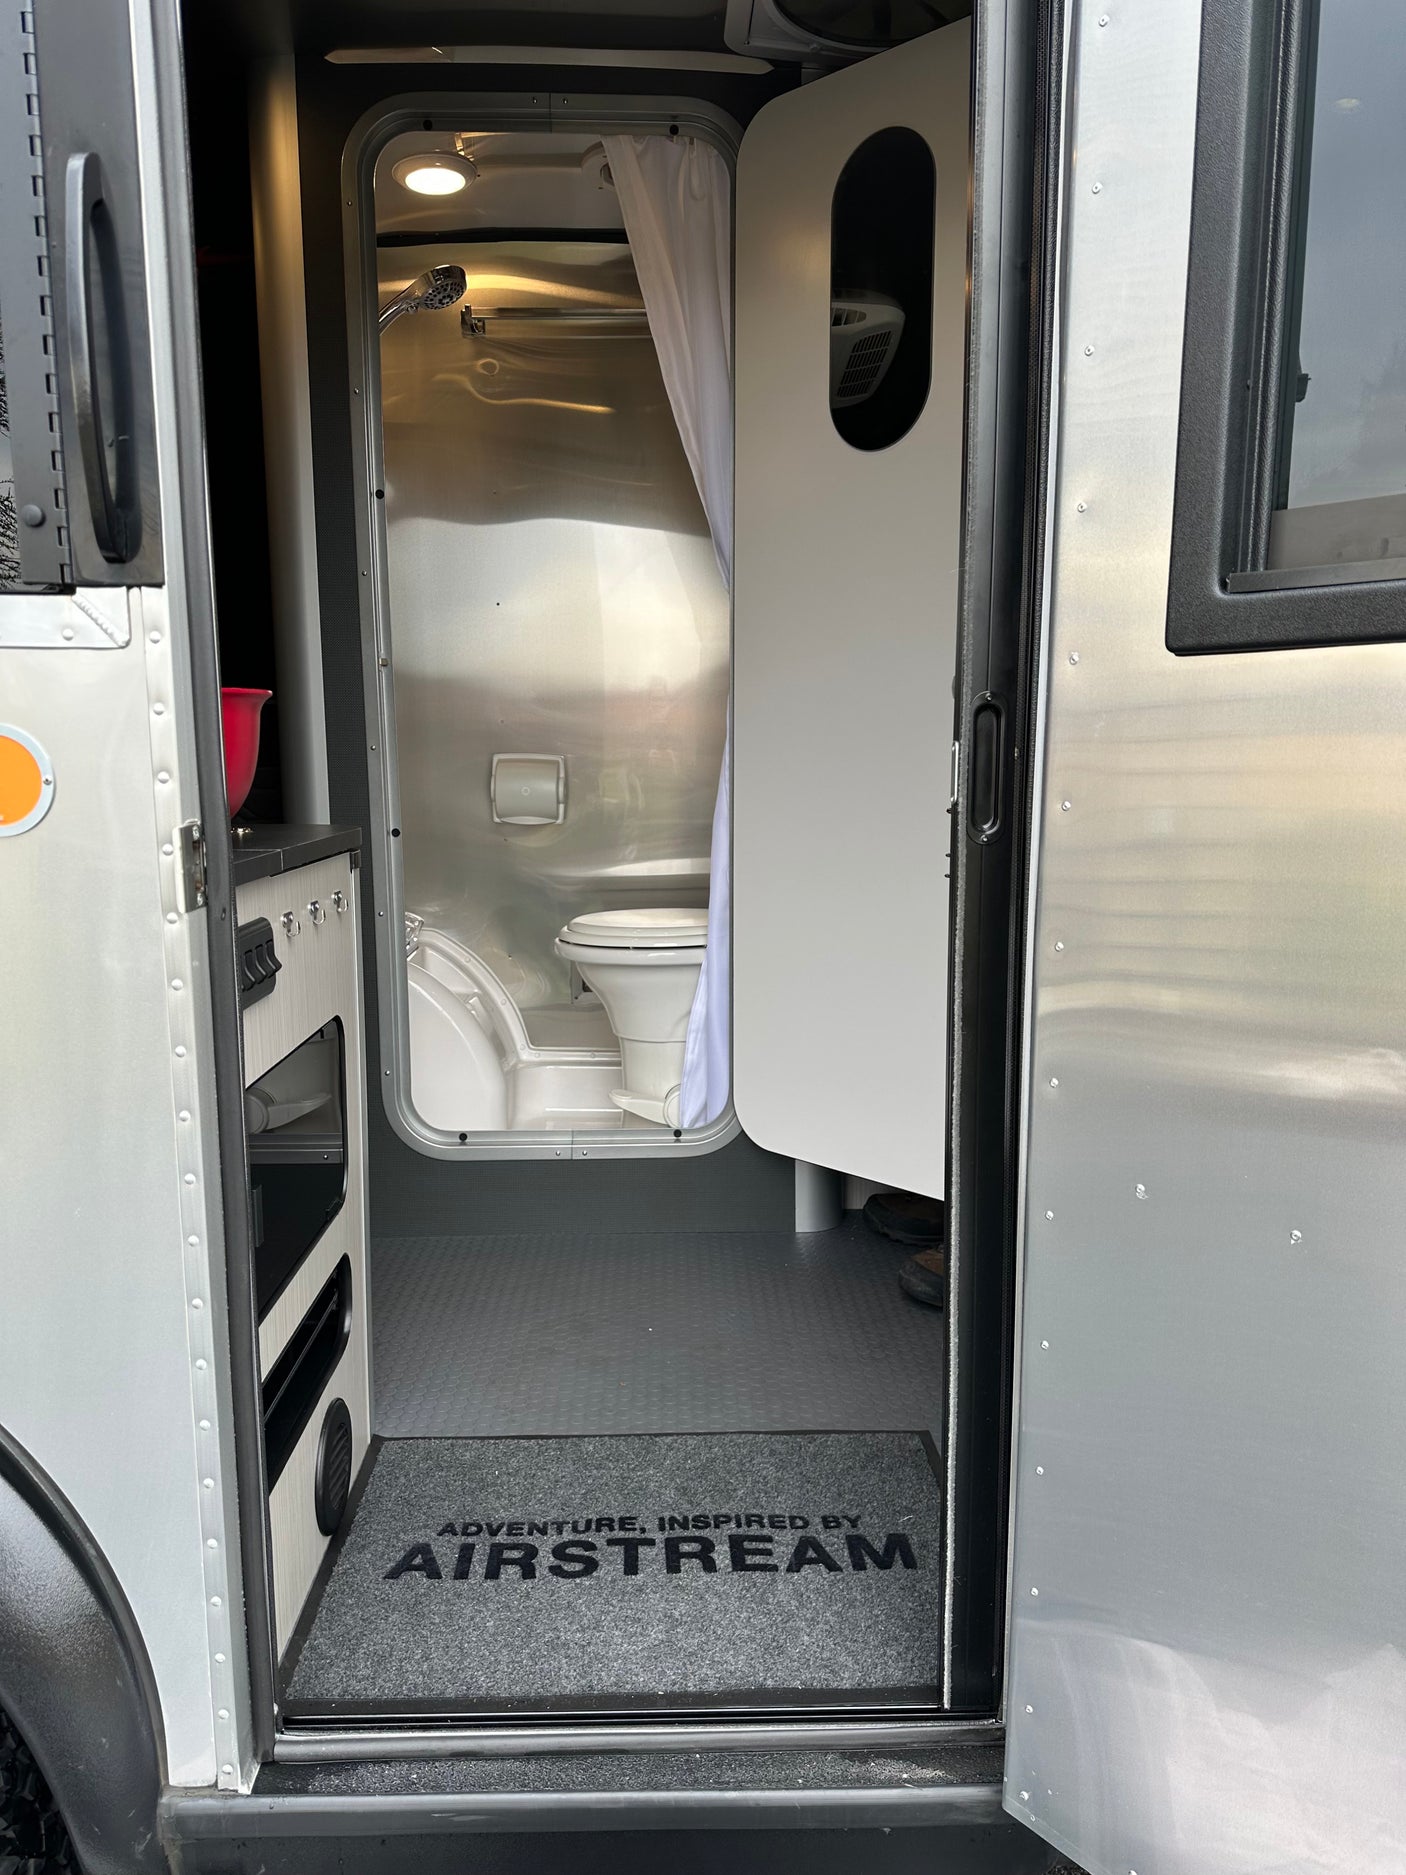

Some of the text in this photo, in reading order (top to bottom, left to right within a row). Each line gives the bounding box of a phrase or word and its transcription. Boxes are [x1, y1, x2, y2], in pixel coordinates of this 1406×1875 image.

[436, 1514, 862, 1537] ADVENTURE, INSPIRED BY
[383, 1533, 918, 1580] AIRSTREAM
